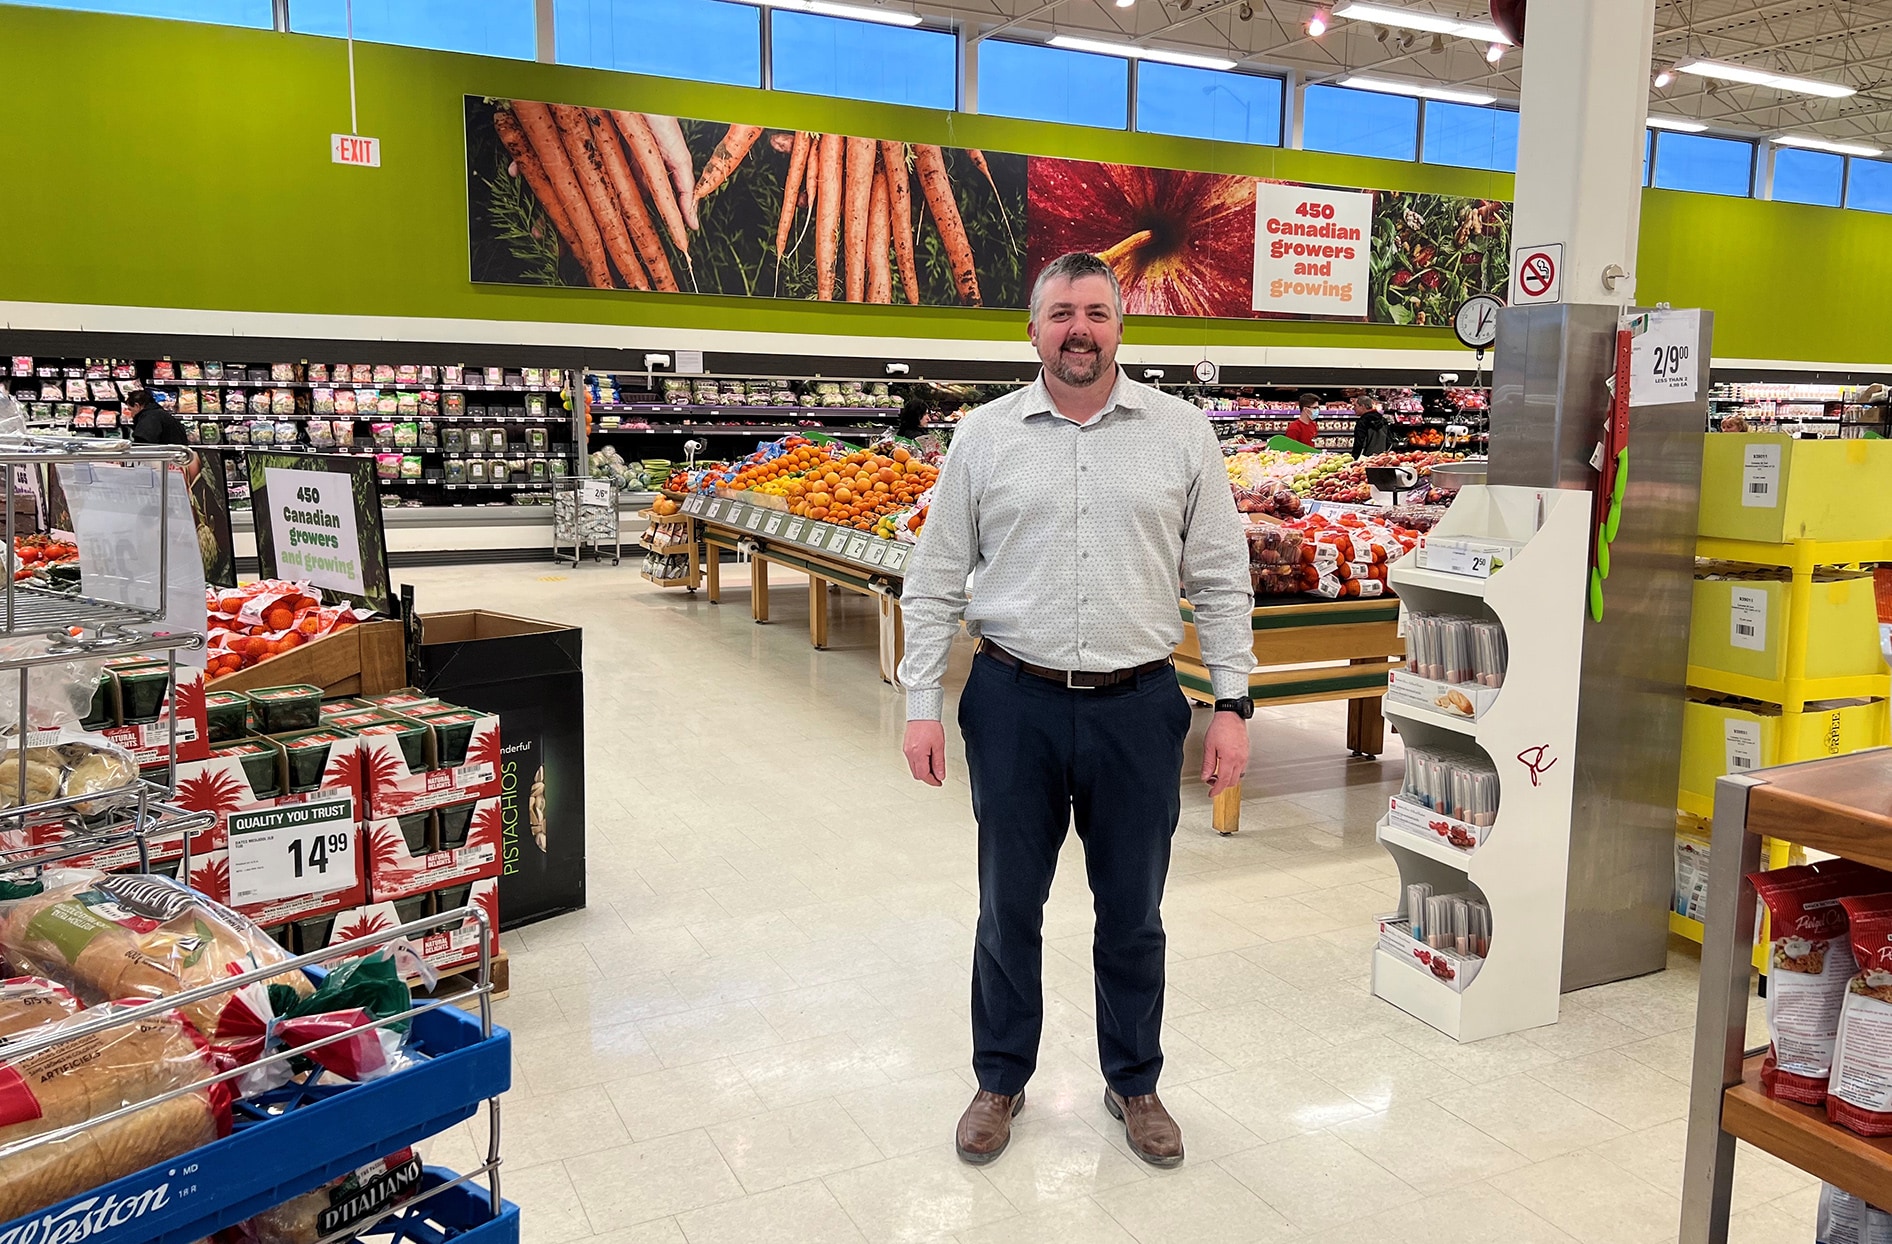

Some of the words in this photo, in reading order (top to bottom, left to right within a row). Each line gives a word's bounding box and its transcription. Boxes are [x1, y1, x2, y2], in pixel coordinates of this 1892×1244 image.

[340, 137, 372, 163] EXIT
[1295, 202, 1335, 220] 450
[1266, 218, 1361, 241] Canadian
[1270, 239, 1356, 260] growers
[1294, 261, 1332, 277] and
[1270, 278, 1353, 302] growing
[297, 487, 320, 504] 450
[283, 507, 341, 528] Canadian
[289, 528, 339, 548] growers
[281, 551, 303, 566] and
[304, 554, 355, 580] growing
[107, 733, 137, 744] ATURAL
[1828, 712, 1841, 755] URPEE
[500, 741, 532, 755] nderful
[236, 813, 284, 830] QUALITY
[287, 810, 309, 822] YOU
[311, 805, 346, 819] TRUST
[501, 761, 520, 876] PISTACHIOS
[40, 1051, 101, 1084] ARTIFICIELS
[182, 1163, 199, 1176] MD
[325, 1161, 420, 1229] D'ITALIANO
[0, 1183, 170, 1244] Weston
